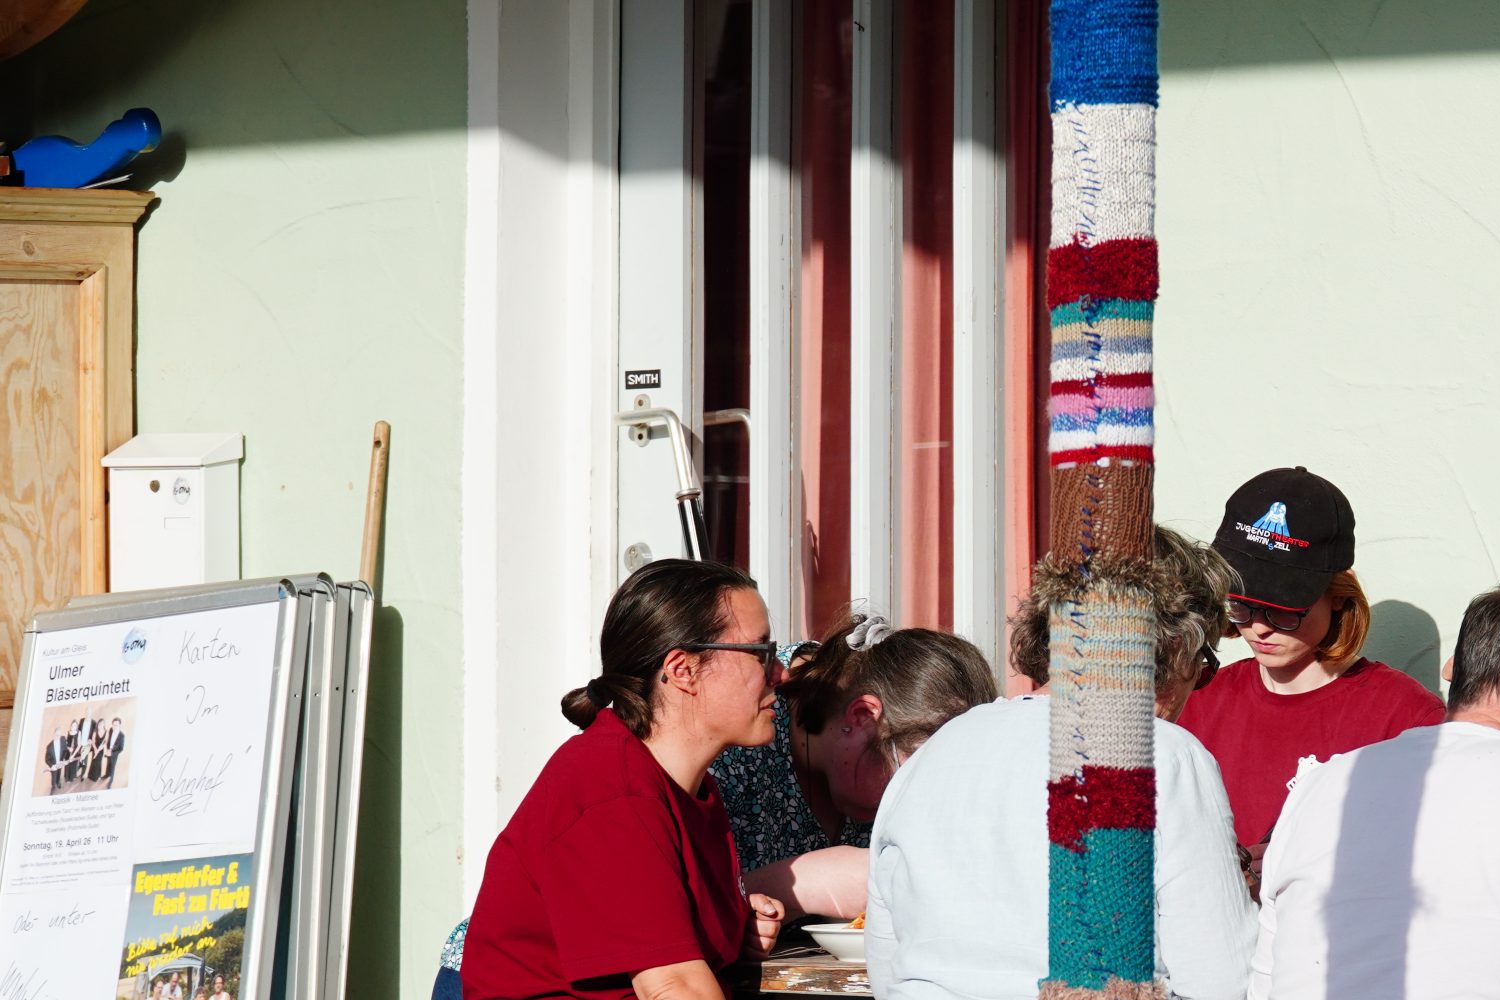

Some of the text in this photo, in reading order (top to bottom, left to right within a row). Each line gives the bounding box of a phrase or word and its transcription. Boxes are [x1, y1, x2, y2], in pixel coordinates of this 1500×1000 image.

[627, 373, 659, 385] SMITH
[178, 627, 240, 664] Karten
[49, 665, 84, 680] Ulmer
[46, 678, 130, 703] Bläserquintett
[65, 838, 82, 848] April
[83, 836, 92, 845] 26
[97, 835, 104, 844] 11
[106, 833, 120, 844] Uhr
[134, 864, 225, 895] Egersdörfer
[152, 892, 186, 916] Fast
[188, 894, 207, 913] zu
